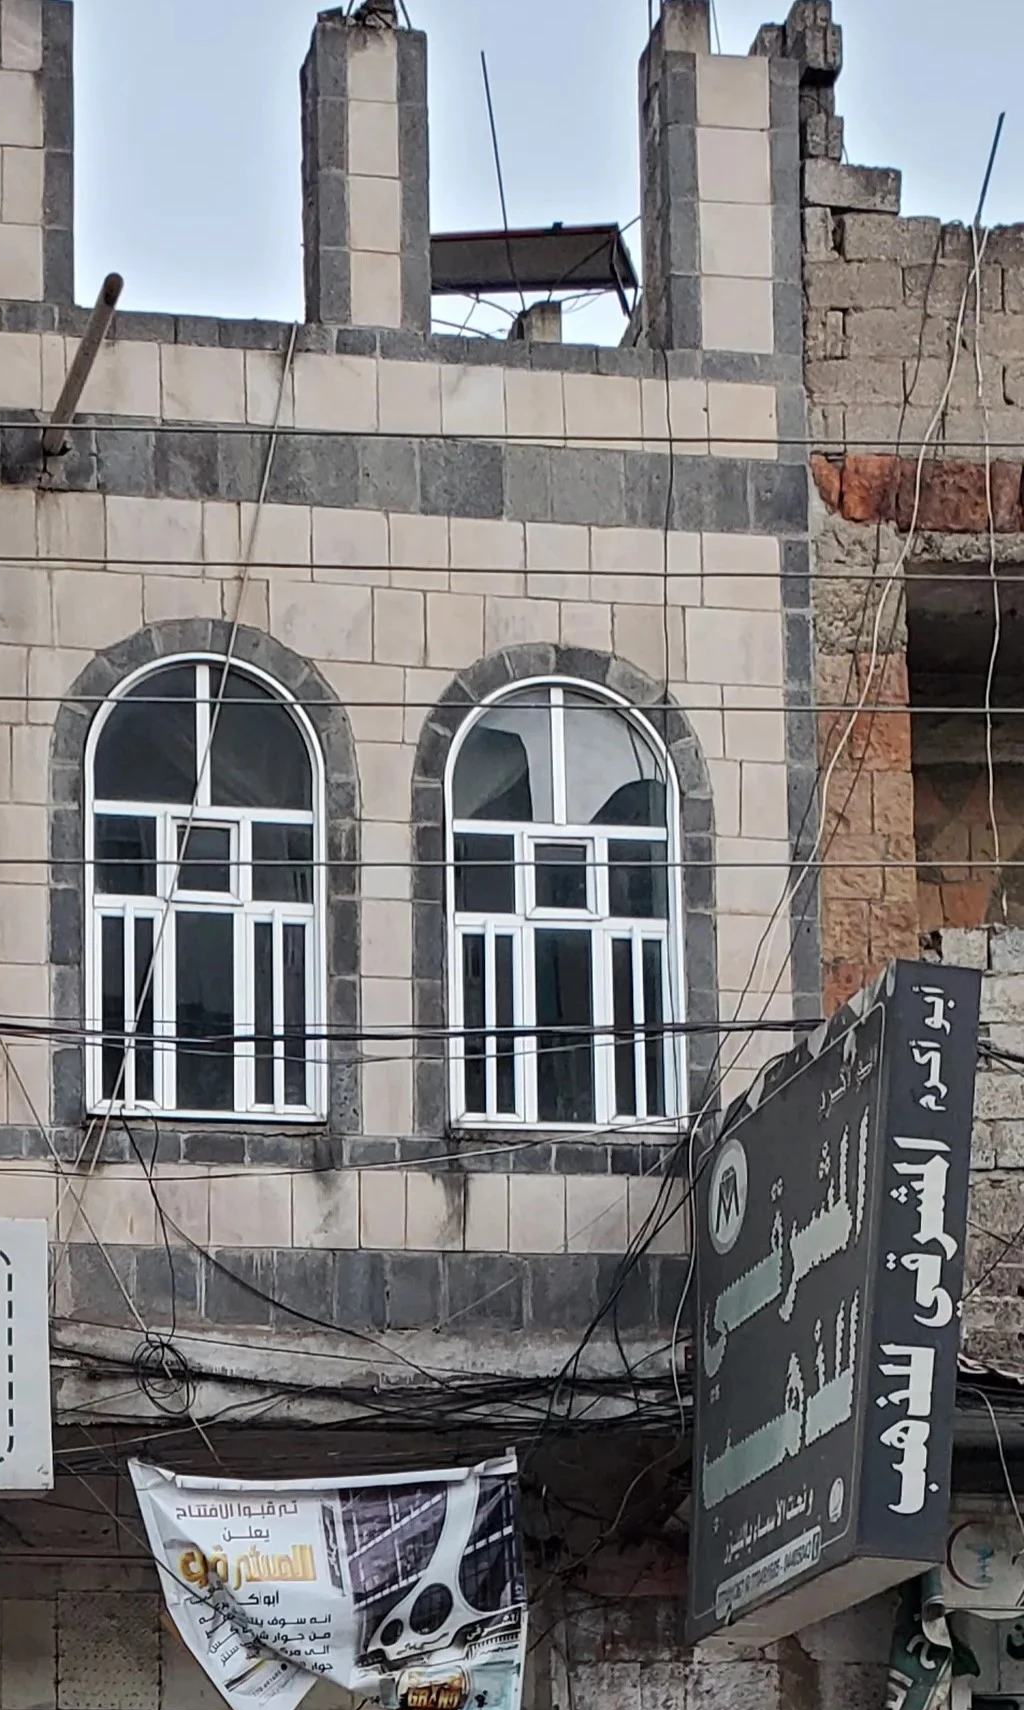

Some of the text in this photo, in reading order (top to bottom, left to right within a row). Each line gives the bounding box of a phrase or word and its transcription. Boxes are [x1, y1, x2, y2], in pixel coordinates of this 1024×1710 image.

[878, 1343, 939, 1515] للذهب
[175, 1500, 298, 1521] ترقبوا الافتتاح
[222, 1525, 270, 1544] يعلن
